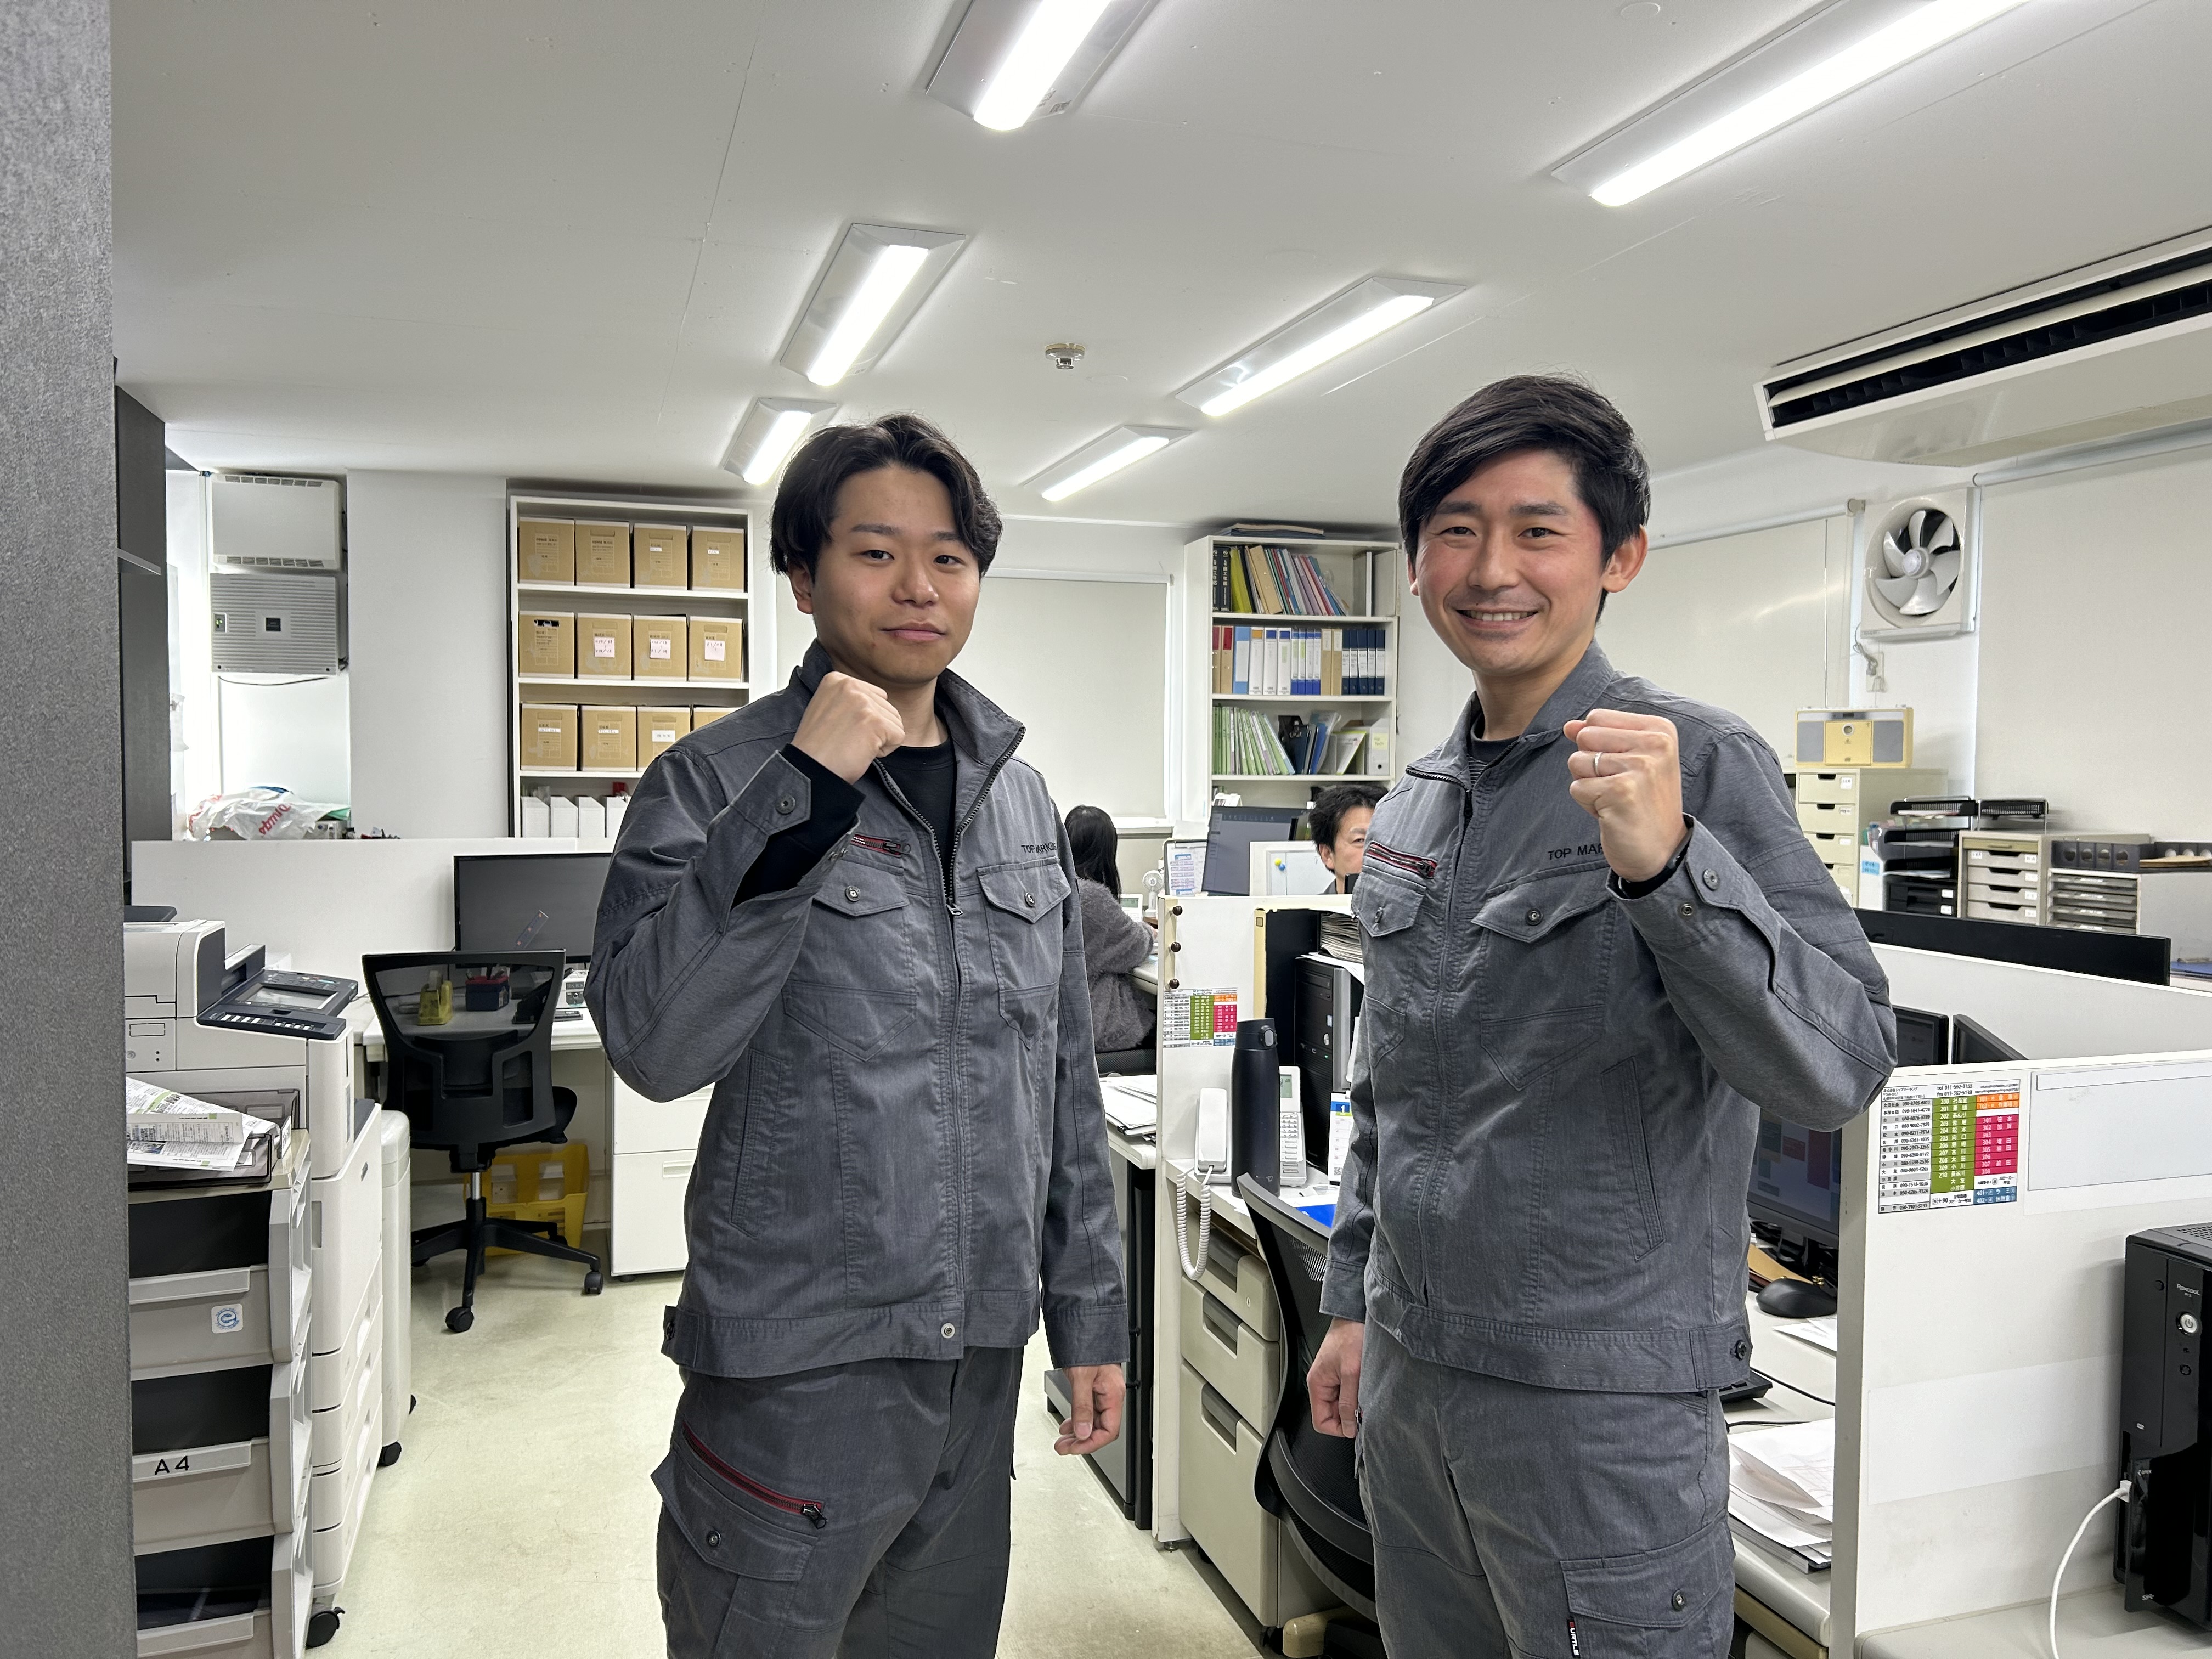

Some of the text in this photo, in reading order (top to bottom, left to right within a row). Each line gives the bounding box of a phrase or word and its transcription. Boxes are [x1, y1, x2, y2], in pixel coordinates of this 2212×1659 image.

[258, 803, 291, 835] Drugs
[1021, 845, 1035, 853] TOP
[1548, 848, 1571, 860] TOP
